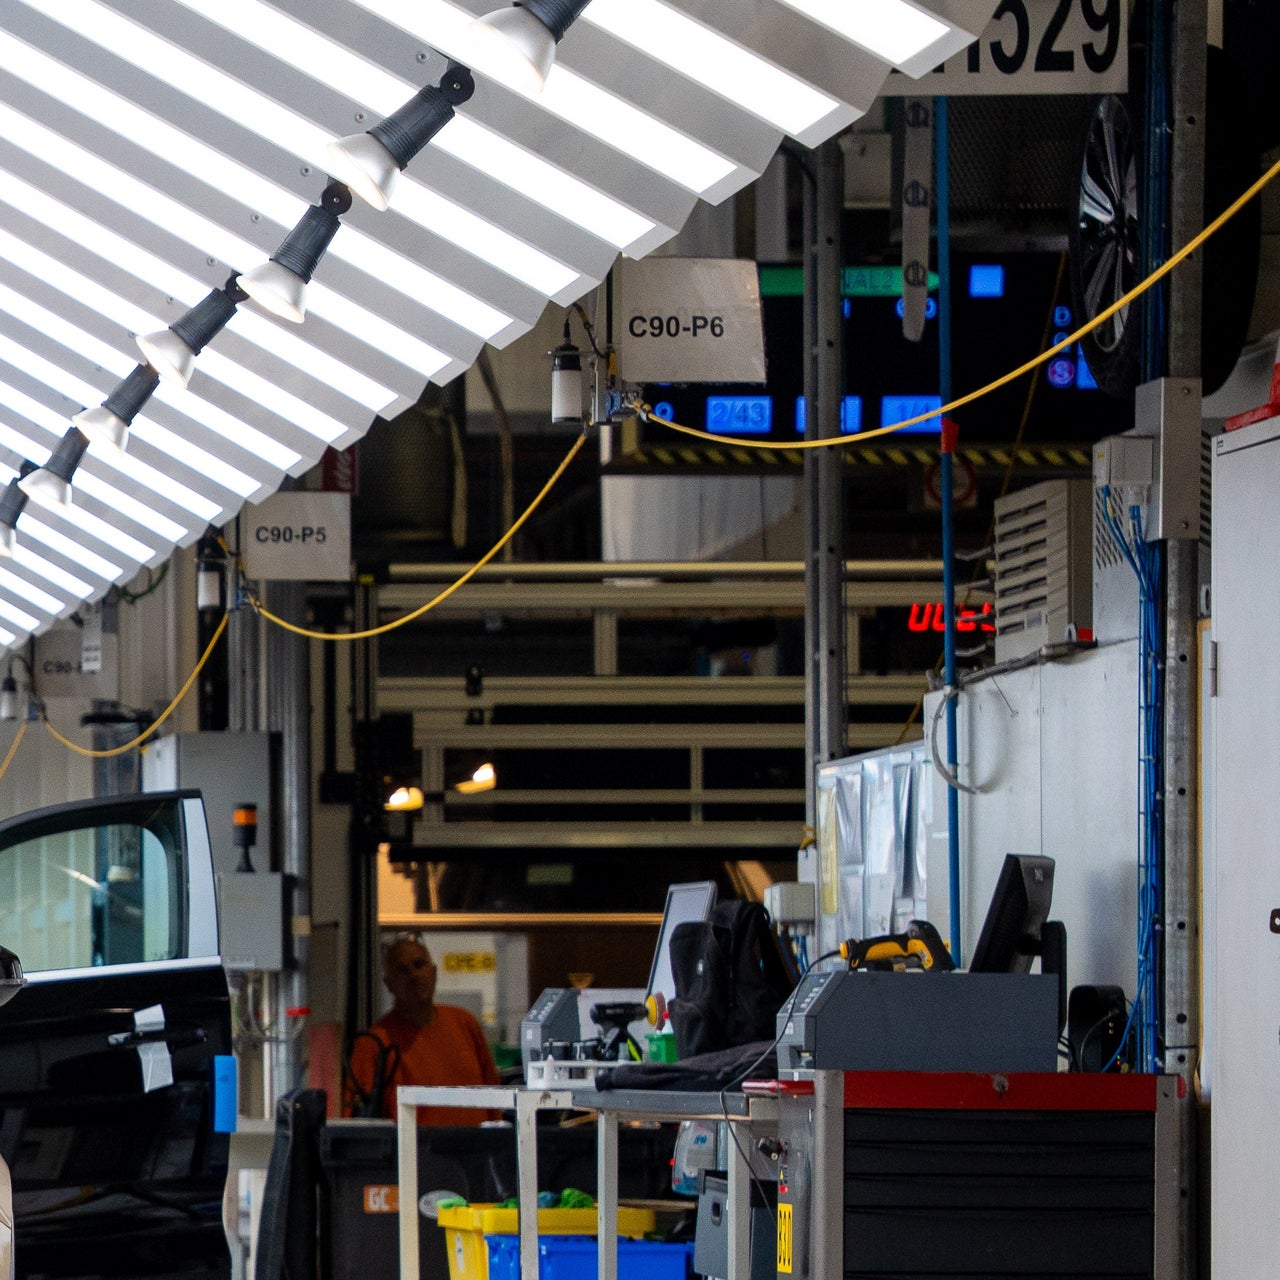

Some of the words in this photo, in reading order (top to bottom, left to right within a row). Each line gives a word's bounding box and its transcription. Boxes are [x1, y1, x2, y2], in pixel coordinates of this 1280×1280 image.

[628, 315, 724, 337] C90-P6
[255, 525, 327, 543] C90-P5
[778, 1209, 792, 1267] B30
